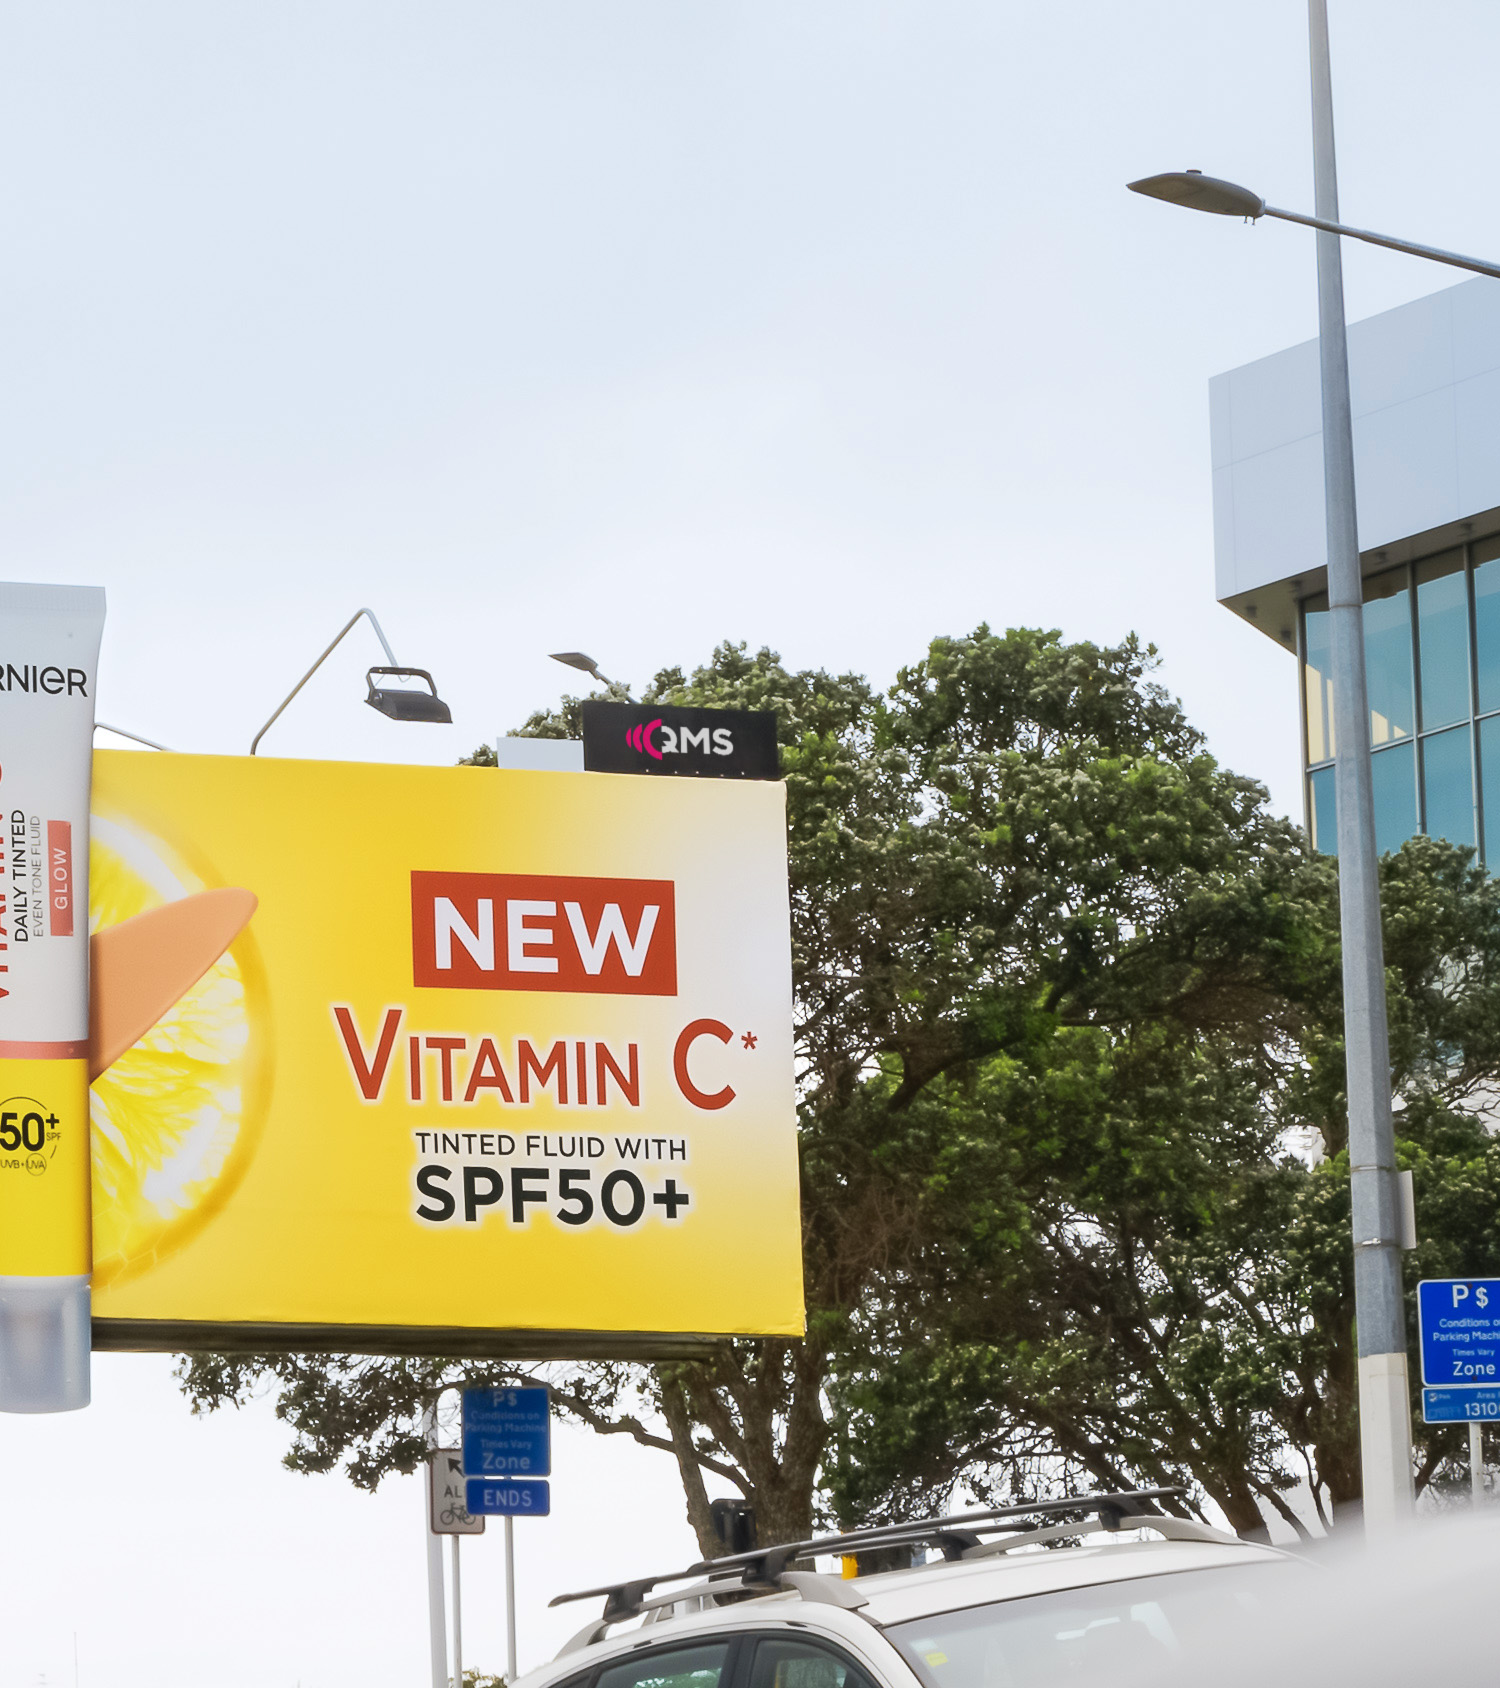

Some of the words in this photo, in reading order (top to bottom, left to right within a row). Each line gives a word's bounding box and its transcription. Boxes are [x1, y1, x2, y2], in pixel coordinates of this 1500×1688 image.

[643, 718, 734, 761] QMS
[29, 815, 41, 855] FLUID
[11, 810, 26, 880] TINTED
[31, 860, 42, 895] TONE
[53, 848, 68, 910] GLOW
[13, 886, 29, 942] DAILY
[32, 899, 44, 937] EVEN
[434, 896, 660, 977] NEW
[333, 1007, 640, 1107] VITAMIN
[46, 1132, 61, 1141] SPF
[415, 1132, 515, 1157] TINTED
[526, 1135, 605, 1159] FLUID
[615, 1137, 686, 1161] WITH
[0, 1159, 20, 1169] UVB
[415, 1164, 690, 1227] SPF50+
[1439, 1318, 1490, 1328] Conditions
[1433, 1332, 1470, 1342] Parking
[1452, 1348, 1475, 1356] Times
[1453, 1361, 1496, 1376] Zone
[1477, 1391, 1496, 1399] Area
[471, 1410, 525, 1420] Conditions
[527, 1412, 540, 1420] on
[465, 1422, 502, 1434] Parking
[505, 1423, 547, 1433] Machine
[481, 1438, 509, 1448] Times
[511, 1439, 533, 1450] Vary
[483, 1452, 530, 1470] Zone
[444, 1484, 463, 1499] AL
[484, 1489, 532, 1507] ENDS
